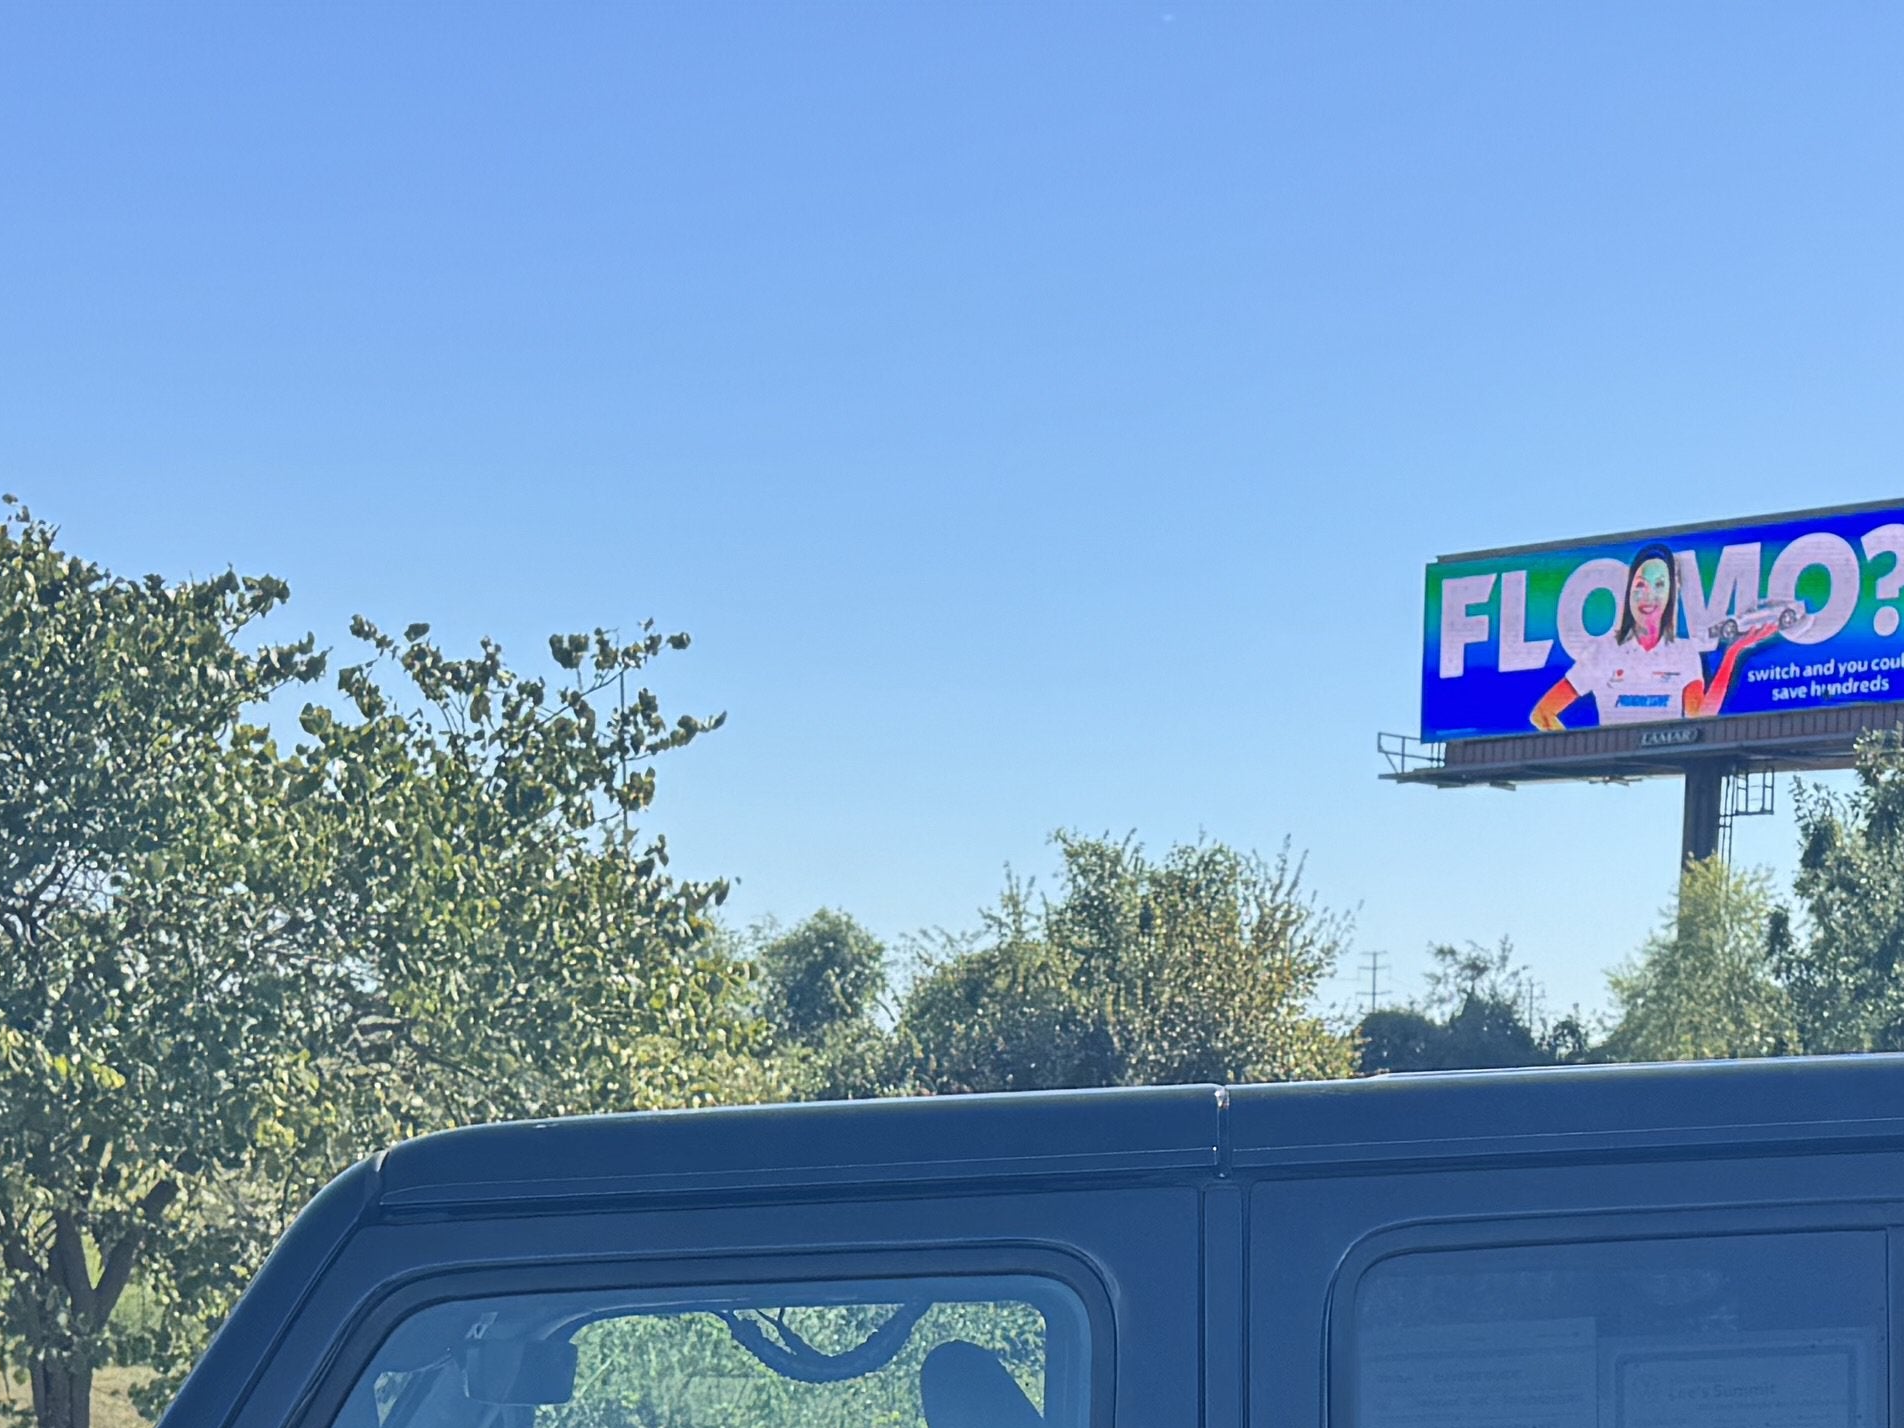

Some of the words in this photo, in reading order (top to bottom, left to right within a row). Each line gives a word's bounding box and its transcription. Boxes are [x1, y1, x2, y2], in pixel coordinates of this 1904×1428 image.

[1748, 662, 1800, 682] switch
[1802, 658, 1835, 677] and
[1838, 659, 1868, 678] you
[1772, 685, 1807, 702] save
[1713, 1383, 1776, 1398] Summit
